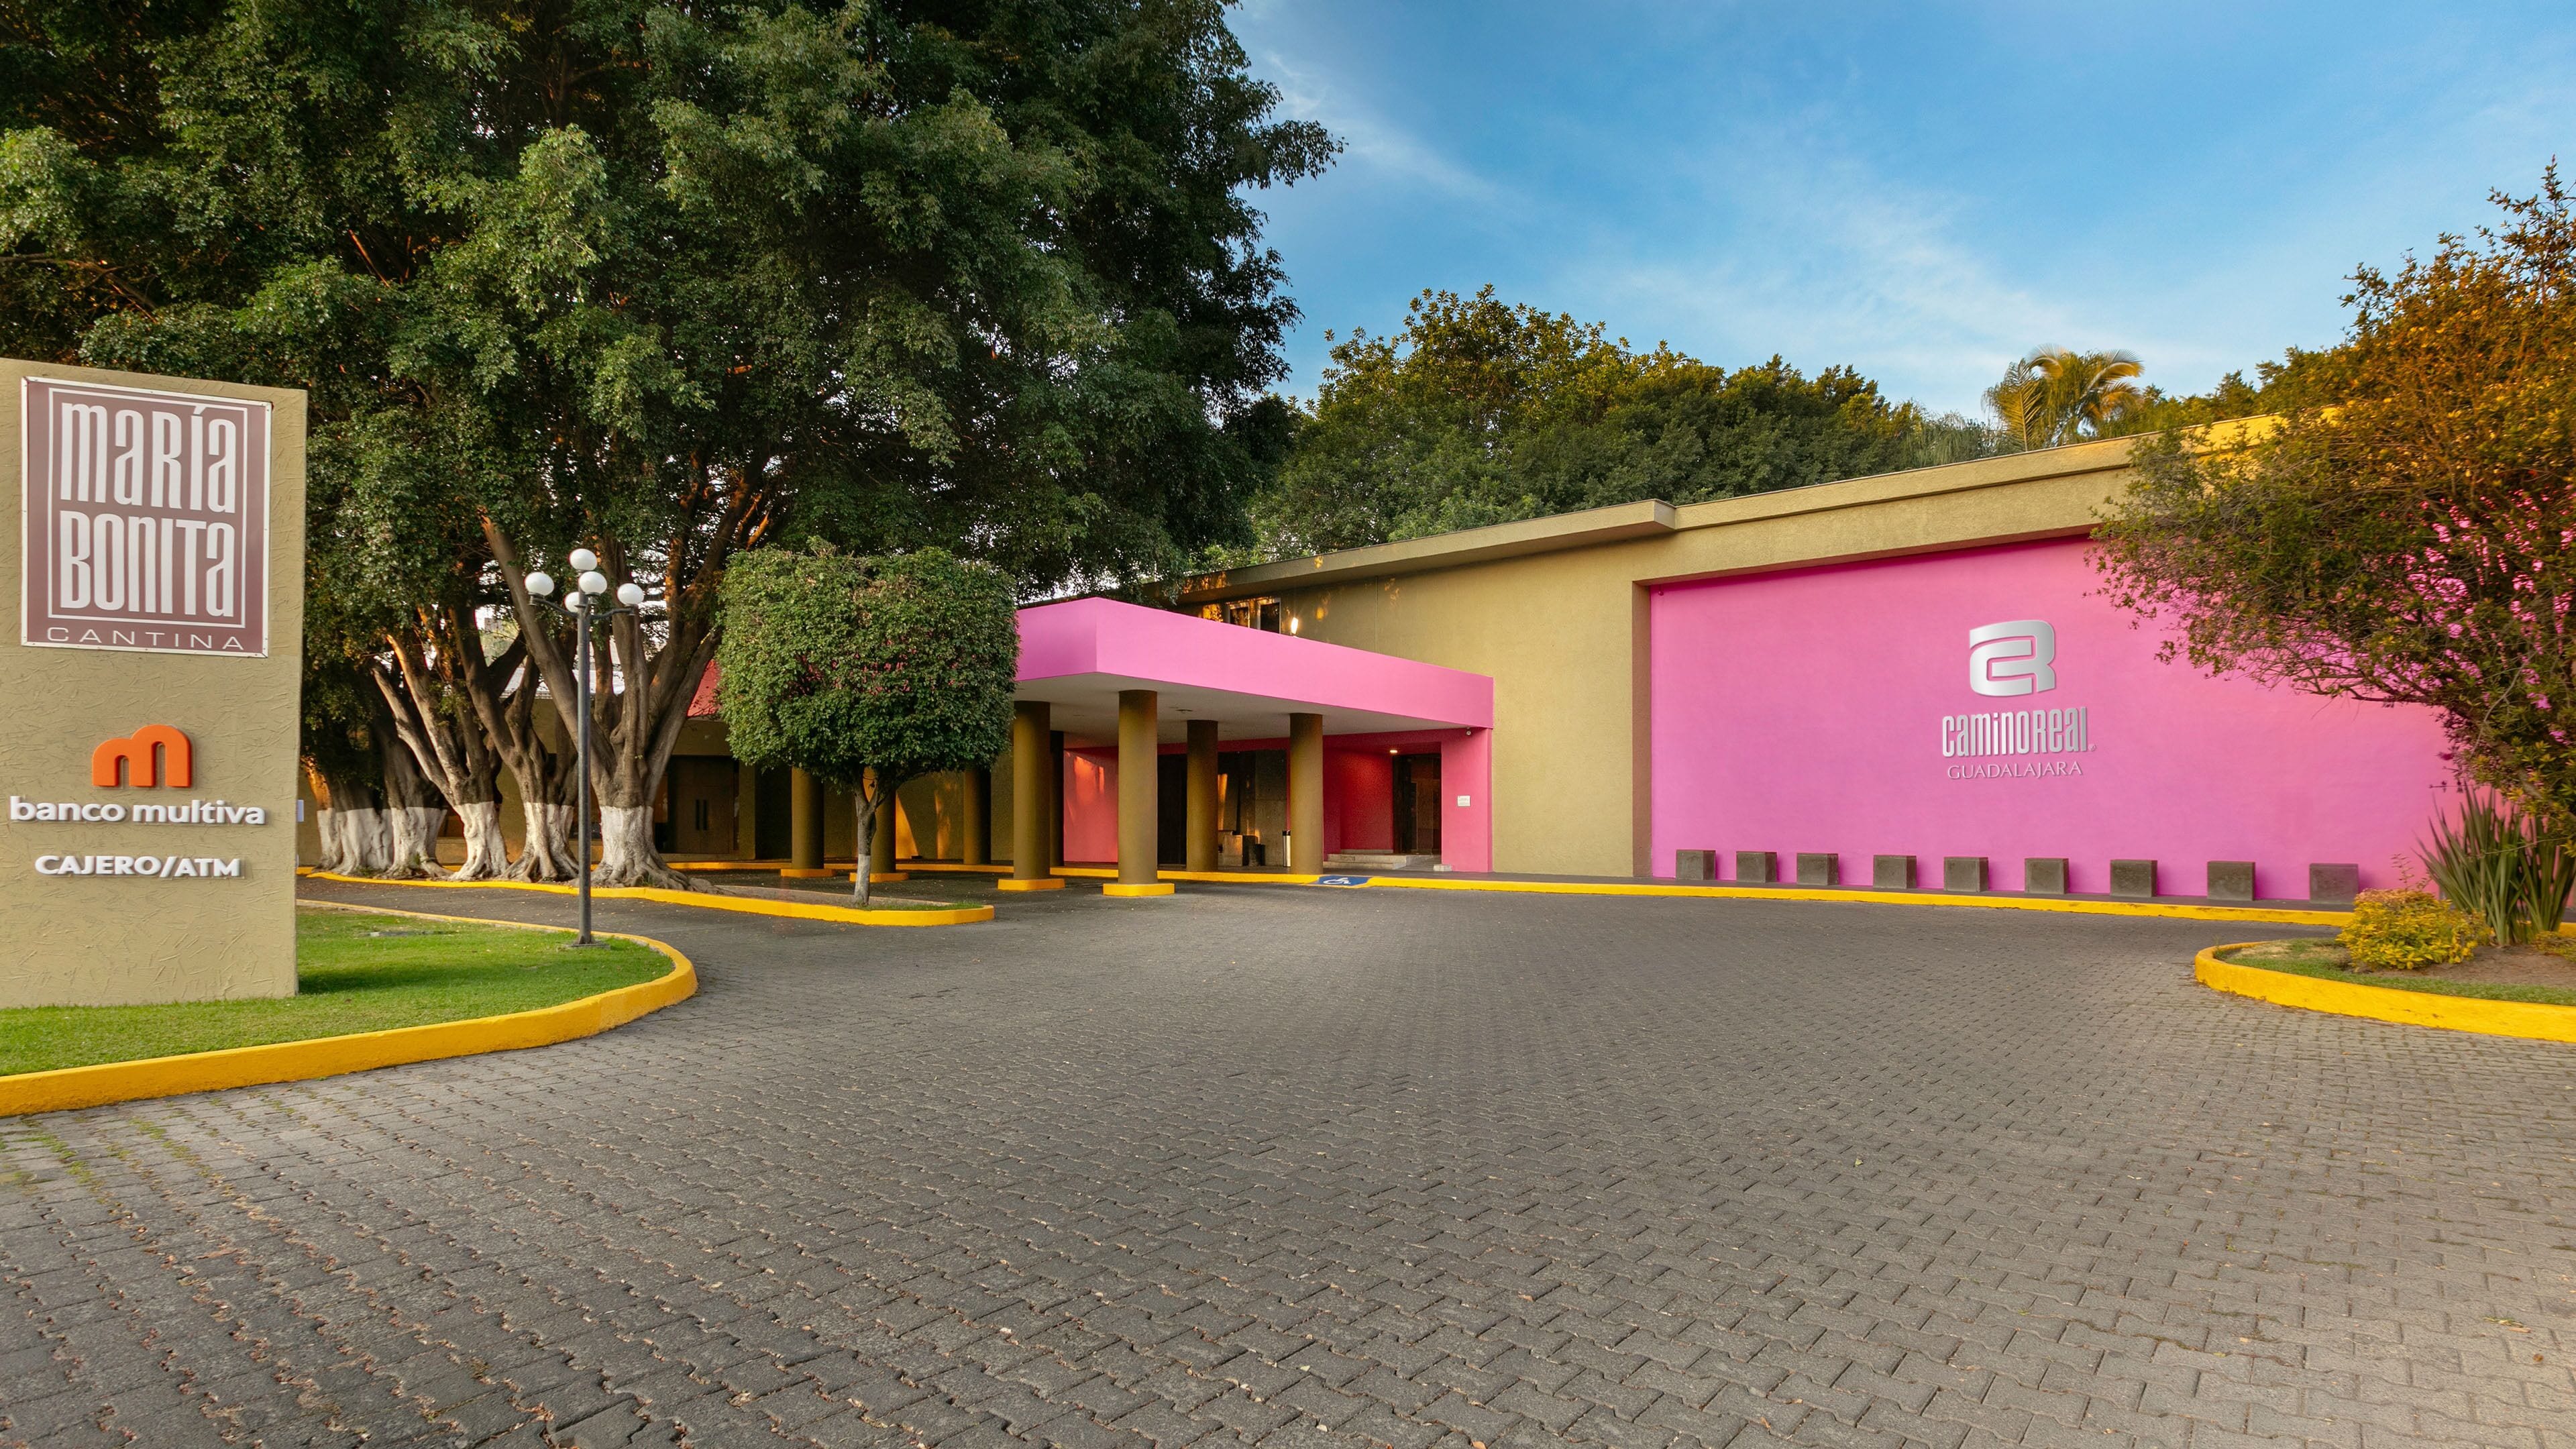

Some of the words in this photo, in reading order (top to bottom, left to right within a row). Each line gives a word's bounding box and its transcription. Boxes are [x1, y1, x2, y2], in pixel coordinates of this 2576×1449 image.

[48, 627, 244, 651] CANTINA
[1947, 761, 2082, 780] GUADALAJARA
[10, 796, 127, 822] banco
[133, 800, 266, 824] multiva
[34, 855, 241, 878] CAJERO/ATM
